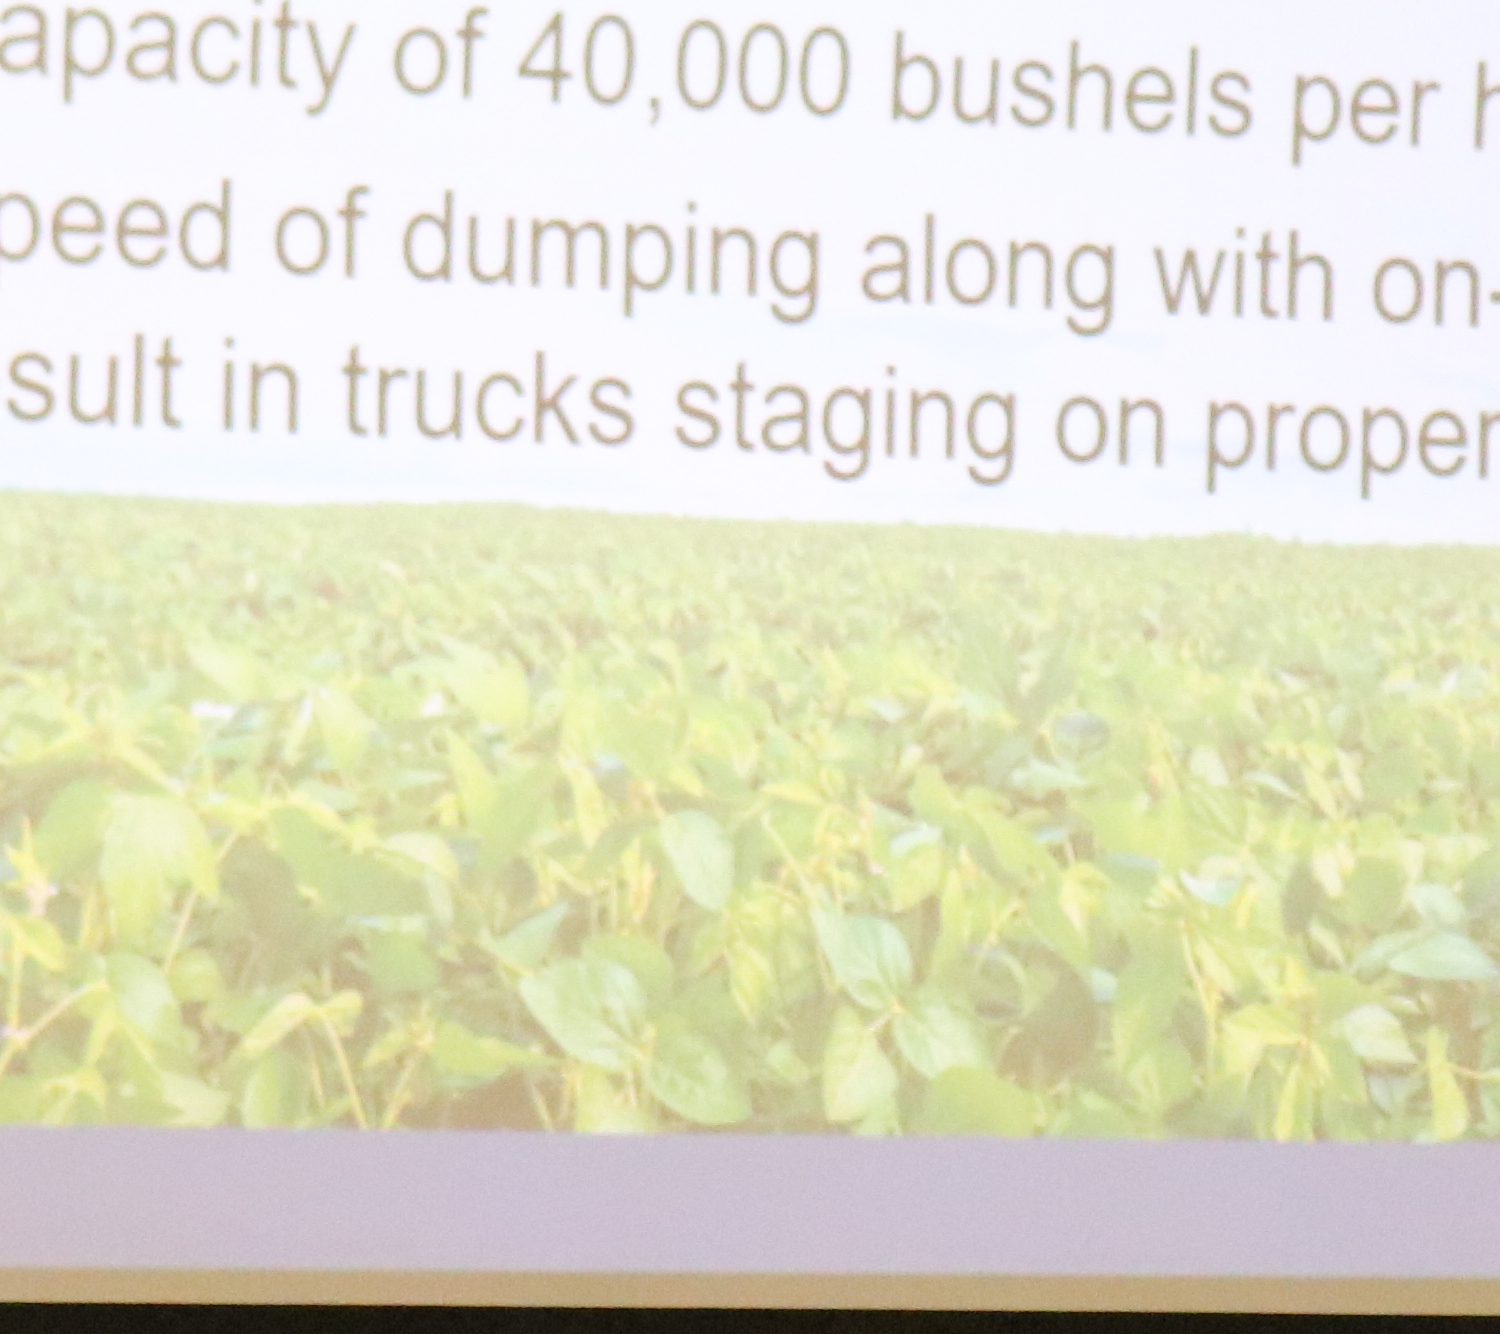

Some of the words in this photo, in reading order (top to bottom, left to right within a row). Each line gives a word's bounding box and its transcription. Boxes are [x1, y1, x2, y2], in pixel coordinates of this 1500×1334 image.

[390, 3, 490, 100] of
[514, 9, 854, 121] 40,000
[888, 28, 1256, 142] bushels
[1288, 72, 1442, 169] per
[271, 182, 372, 280] of
[399, 188, 823, 329] dumping
[858, 211, 1118, 341] along
[1151, 225, 1337, 323] with
[220, 359, 301, 435] in
[339, 344, 638, 450] trucks
[672, 360, 1019, 490] staging
[1052, 392, 1168, 469] on
